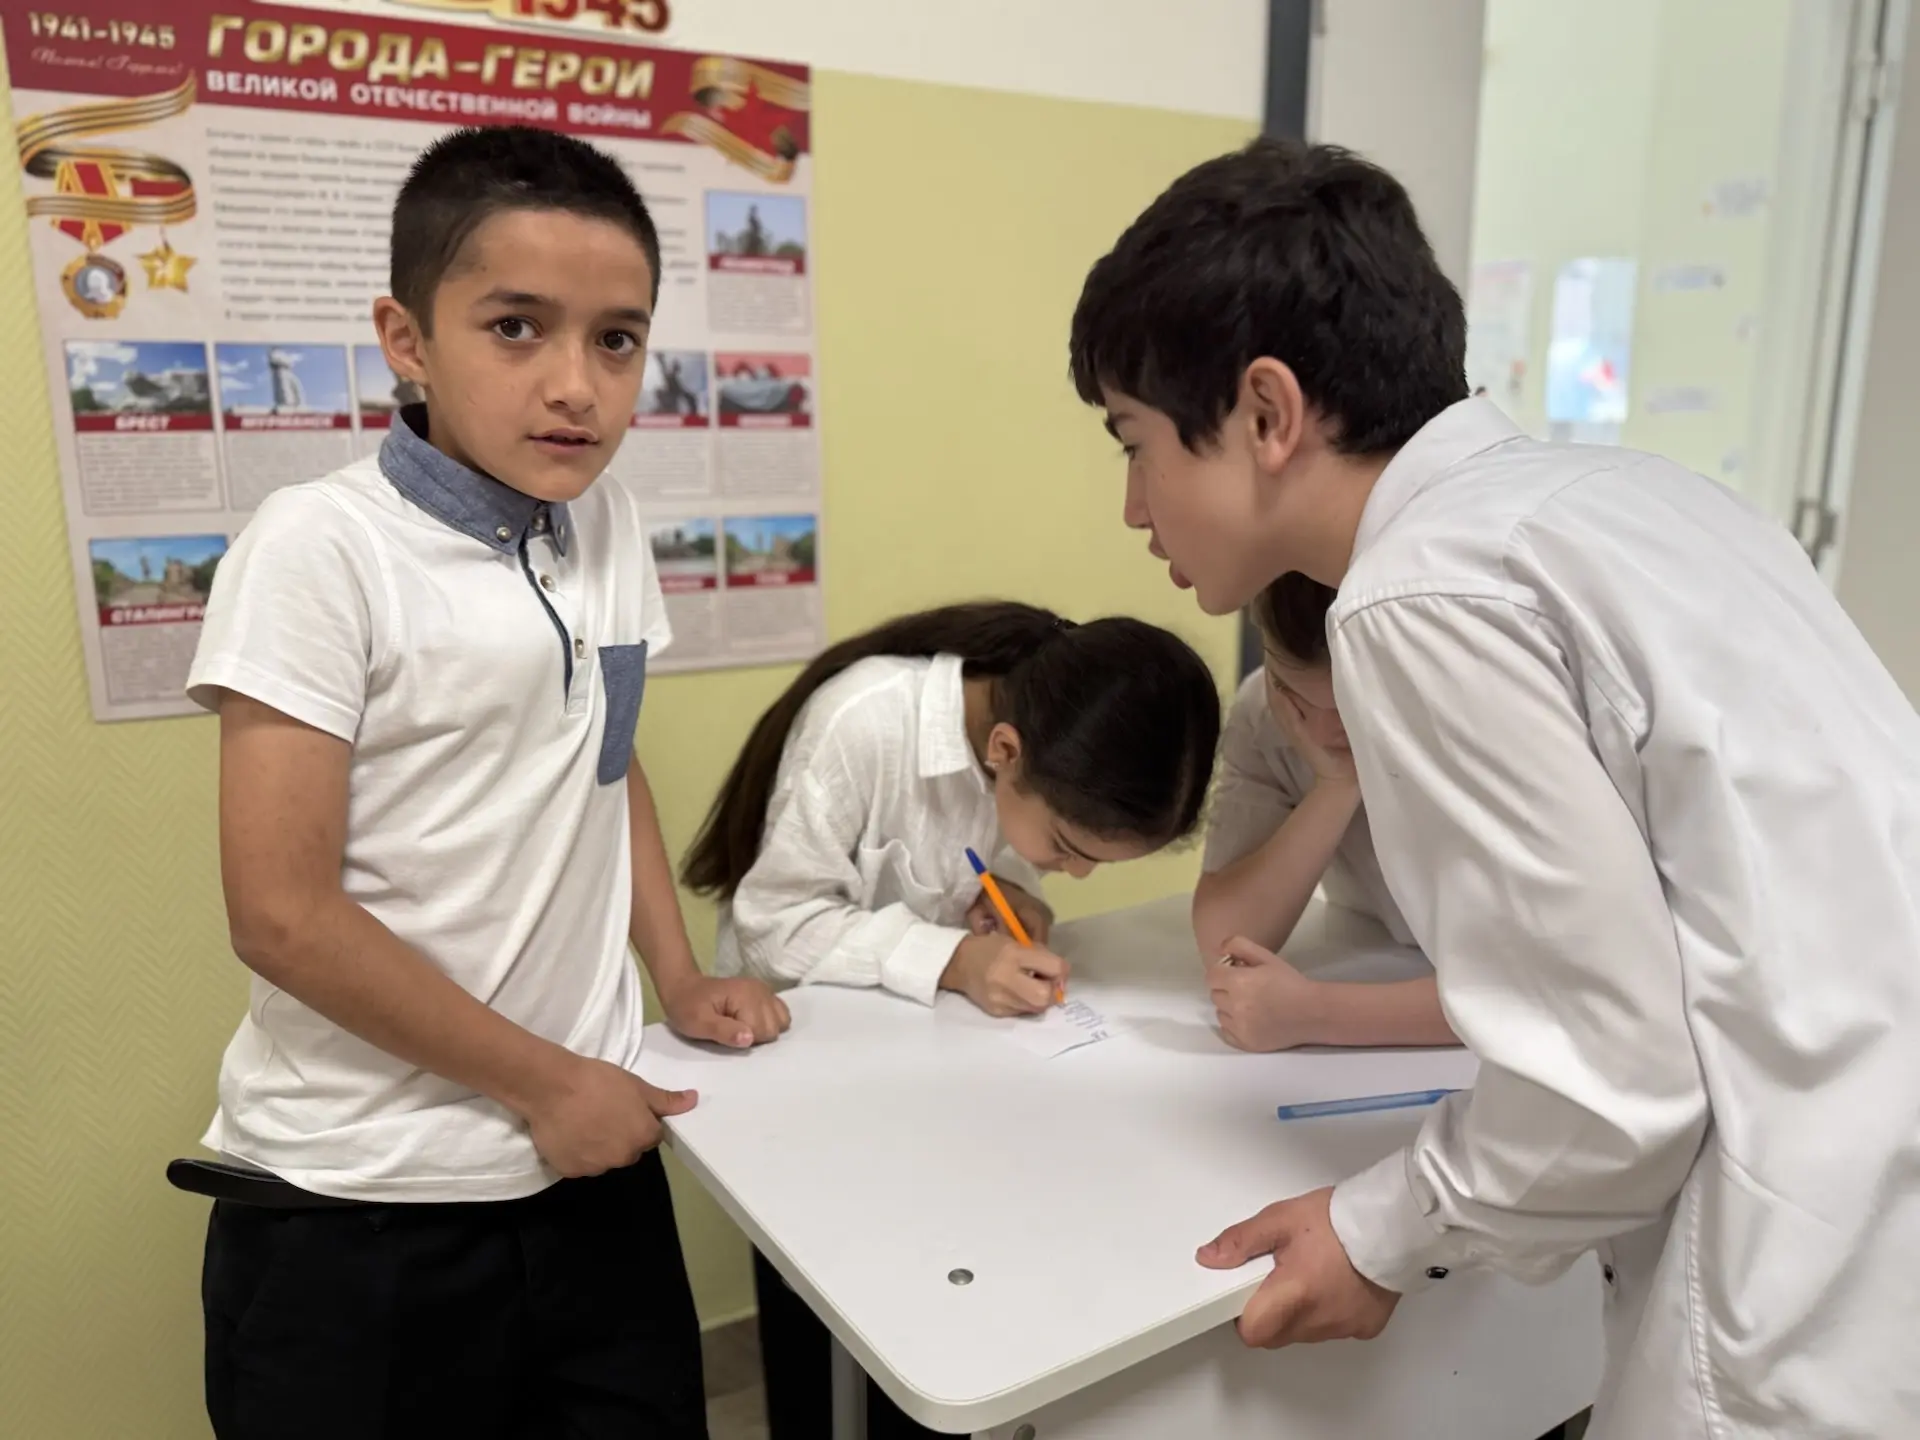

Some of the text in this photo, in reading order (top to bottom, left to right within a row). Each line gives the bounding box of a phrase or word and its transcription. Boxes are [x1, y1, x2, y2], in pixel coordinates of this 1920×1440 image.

[29, 12, 175, 49] 1941-1945
[207, 14, 655, 98] ГОРОДА-ГЕРОИ
[206, 69, 652, 129] ВЕЛИКОЙ ОТЕЧЕСТВЕННОЙ ВОЙНЫ
